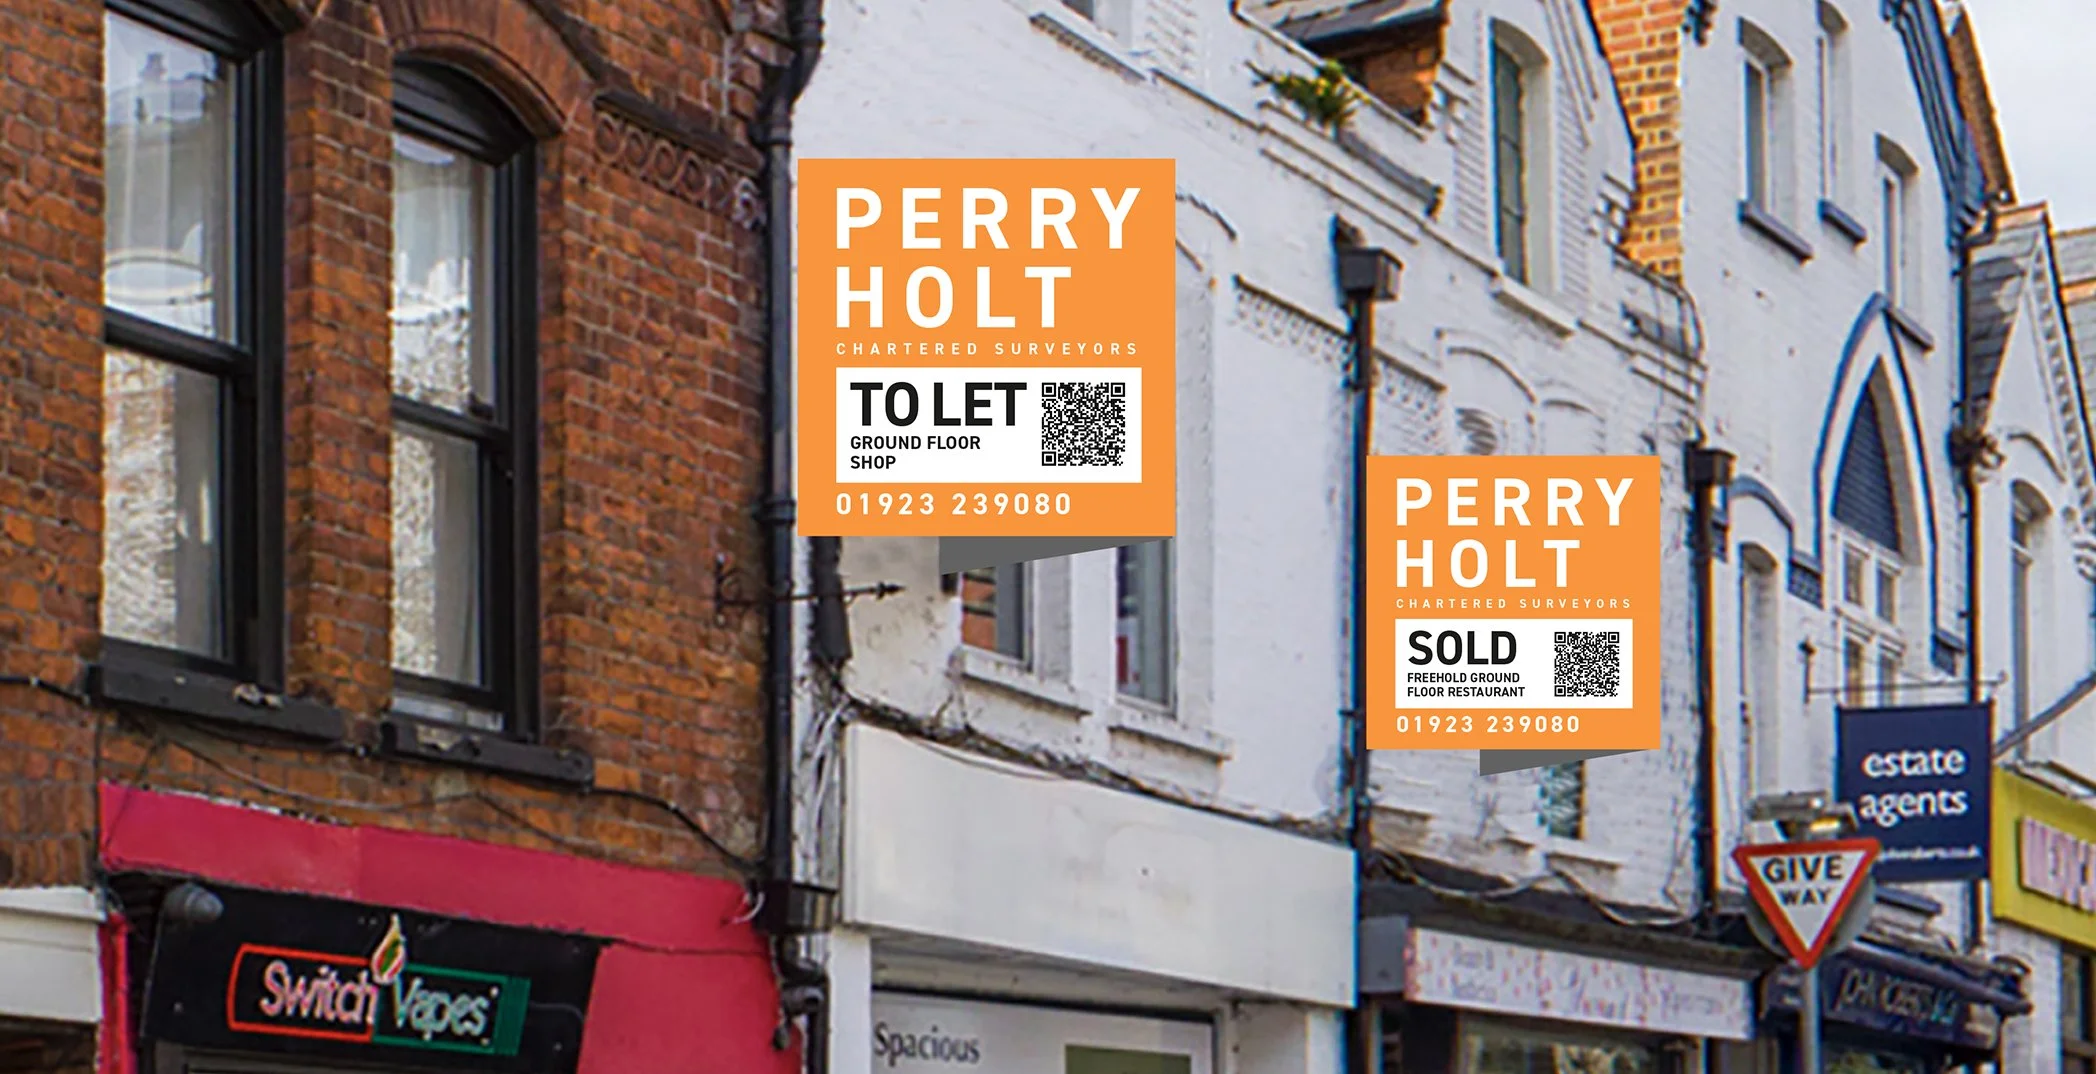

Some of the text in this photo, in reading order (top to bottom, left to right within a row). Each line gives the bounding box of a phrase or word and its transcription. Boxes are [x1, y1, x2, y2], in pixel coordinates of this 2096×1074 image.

[836, 187, 1141, 250] PERRY
[836, 265, 1072, 329] HOLT
[836, 342, 1138, 356] CHARTERED SURVEYORS
[850, 381, 1028, 427] TO LET
[850, 435, 981, 451] GROUND FLOOR
[850, 455, 897, 471] SHOP
[836, 492, 1072, 516] 01923 239080
[1396, 477, 1634, 527] PERRY
[1396, 538, 1581, 589] HOLT
[1396, 598, 1631, 609] CHARTERED SURVEYORS
[1408, 630, 1517, 666] SOLD
[1407, 672, 1520, 683] FREEHOLD GROUND
[1407, 686, 1526, 697] FLOOR RESTAURANT
[1396, 715, 1580, 733] 01923 239080
[1861, 749, 1966, 778] estate
[1859, 789, 1969, 828] agents
[1763, 854, 1843, 883] GIVE
[1779, 886, 1832, 905] WAY
[259, 959, 489, 1042] Switch Vapes
[873, 1020, 980, 1068] Spacious
